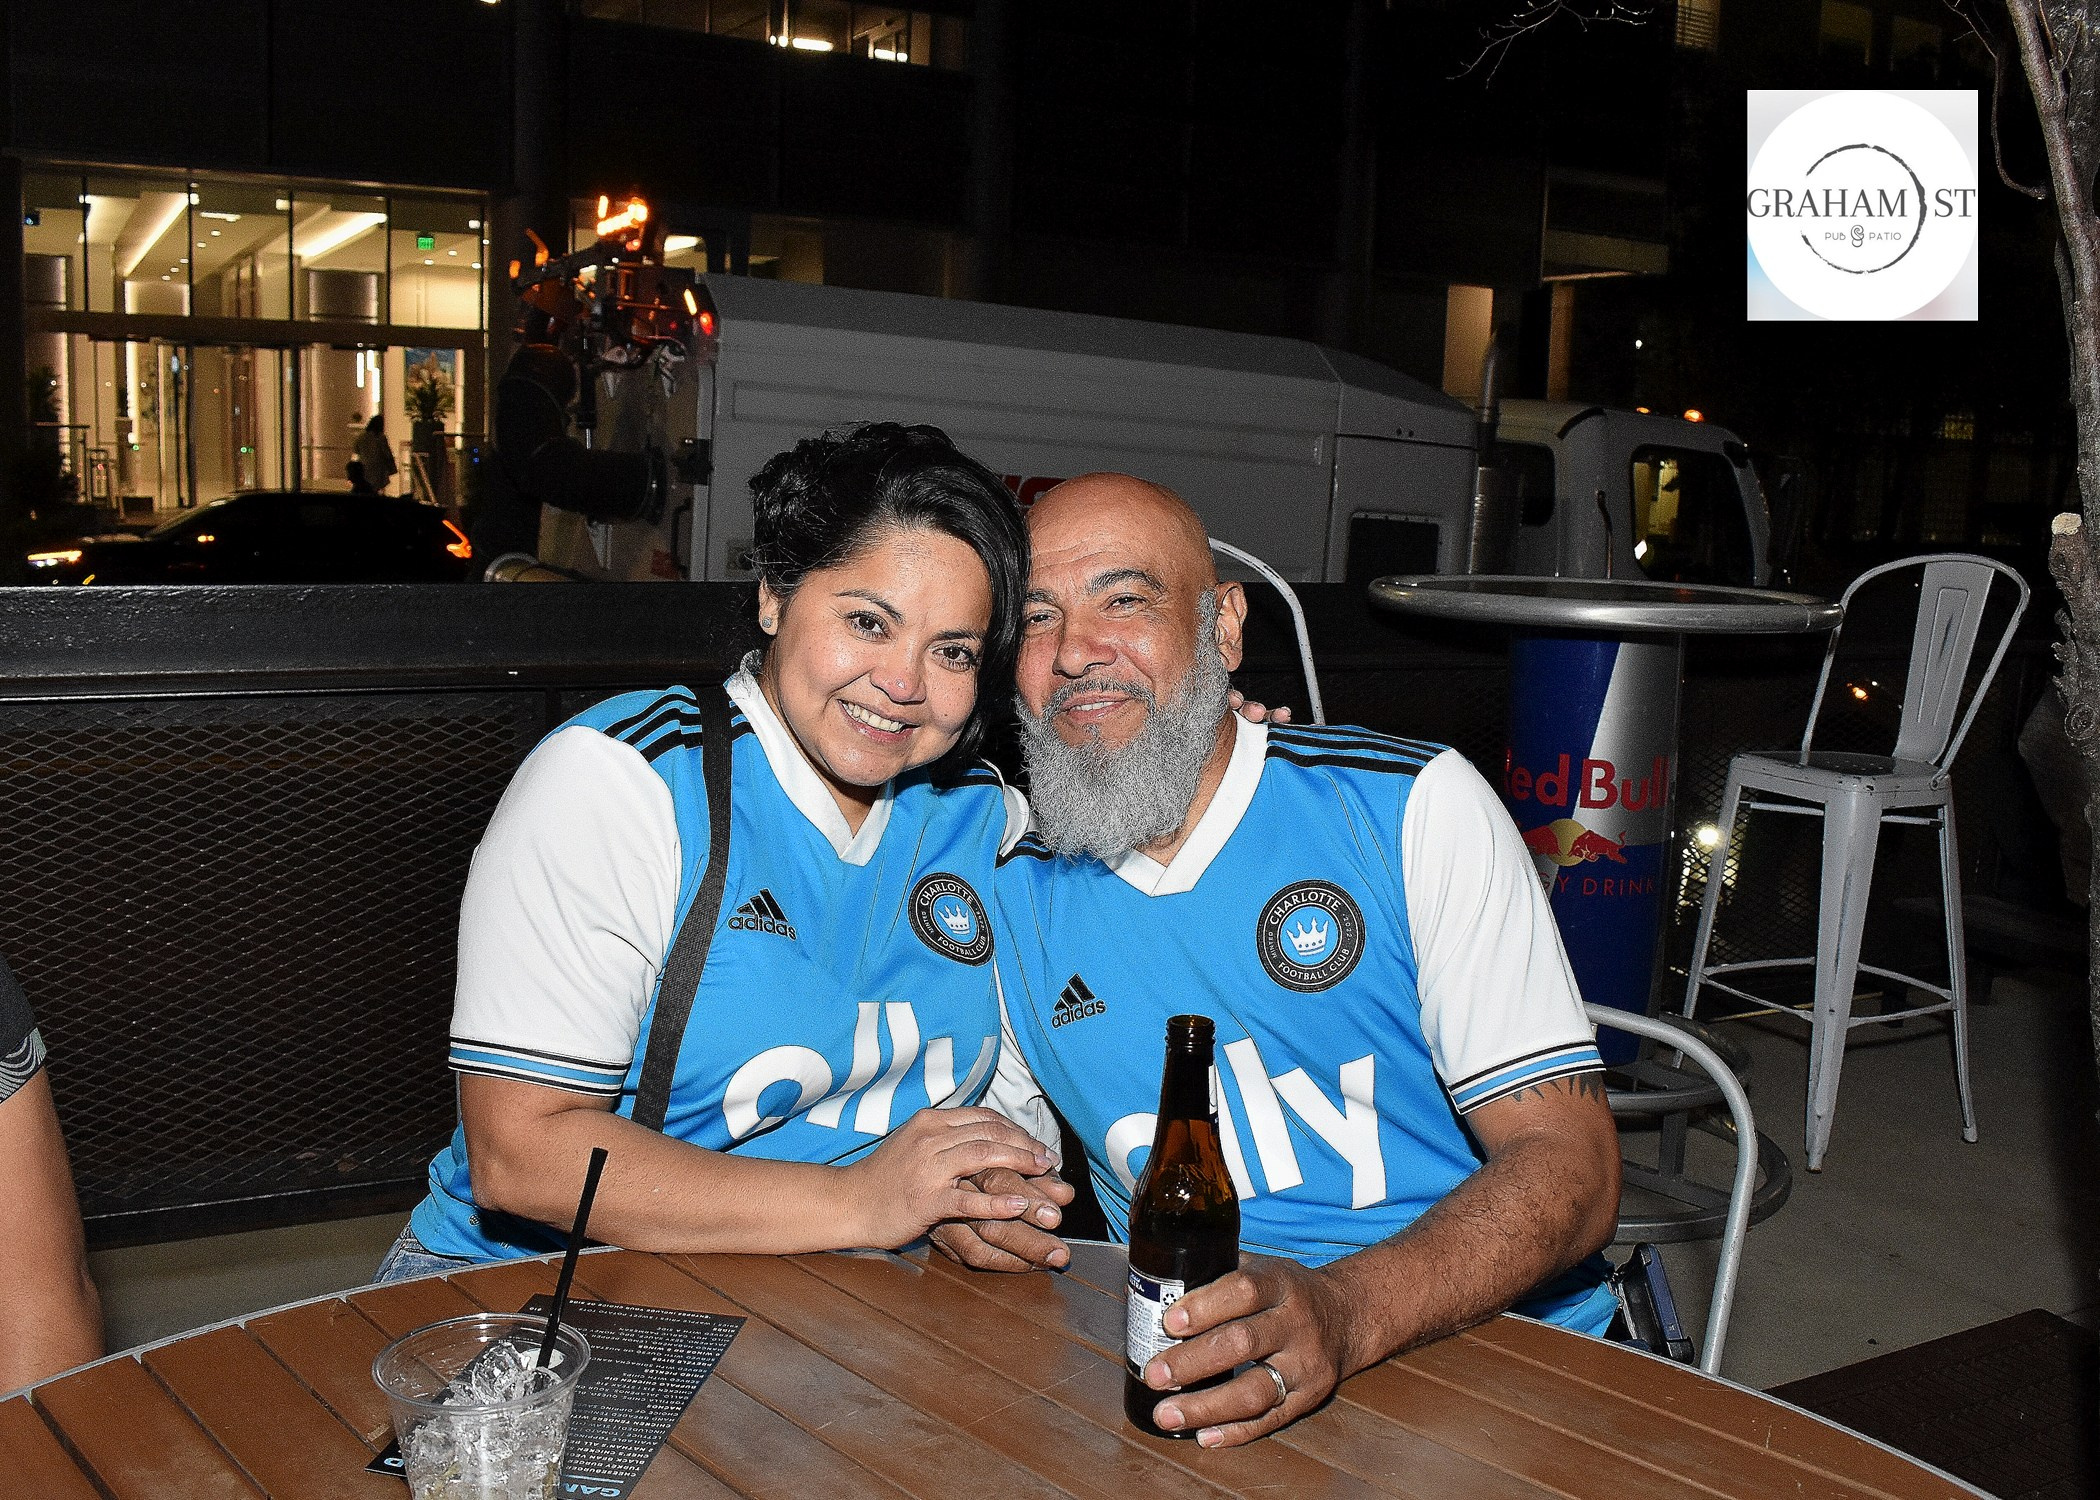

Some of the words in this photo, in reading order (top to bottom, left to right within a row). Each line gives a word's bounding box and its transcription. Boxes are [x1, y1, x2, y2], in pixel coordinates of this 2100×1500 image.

[1579, 754, 1670, 812] Bull
[920, 882, 974, 906] CHARLOTTE
[1269, 891, 1342, 925] CHARLOTTE
[727, 915, 798, 941] adidas
[937, 936, 977, 956] FOOTBALL
[975, 935, 986, 953] CLUB
[1278, 961, 1328, 980] FOOTBALL
[1329, 948, 1350, 971] CLUB
[1051, 998, 1107, 1029] adidas
[601, 1443, 646, 1451] NATHAN'S
[563, 1465, 637, 1477] CHEESEBURGER
[605, 1463, 641, 1471] TURKEY
